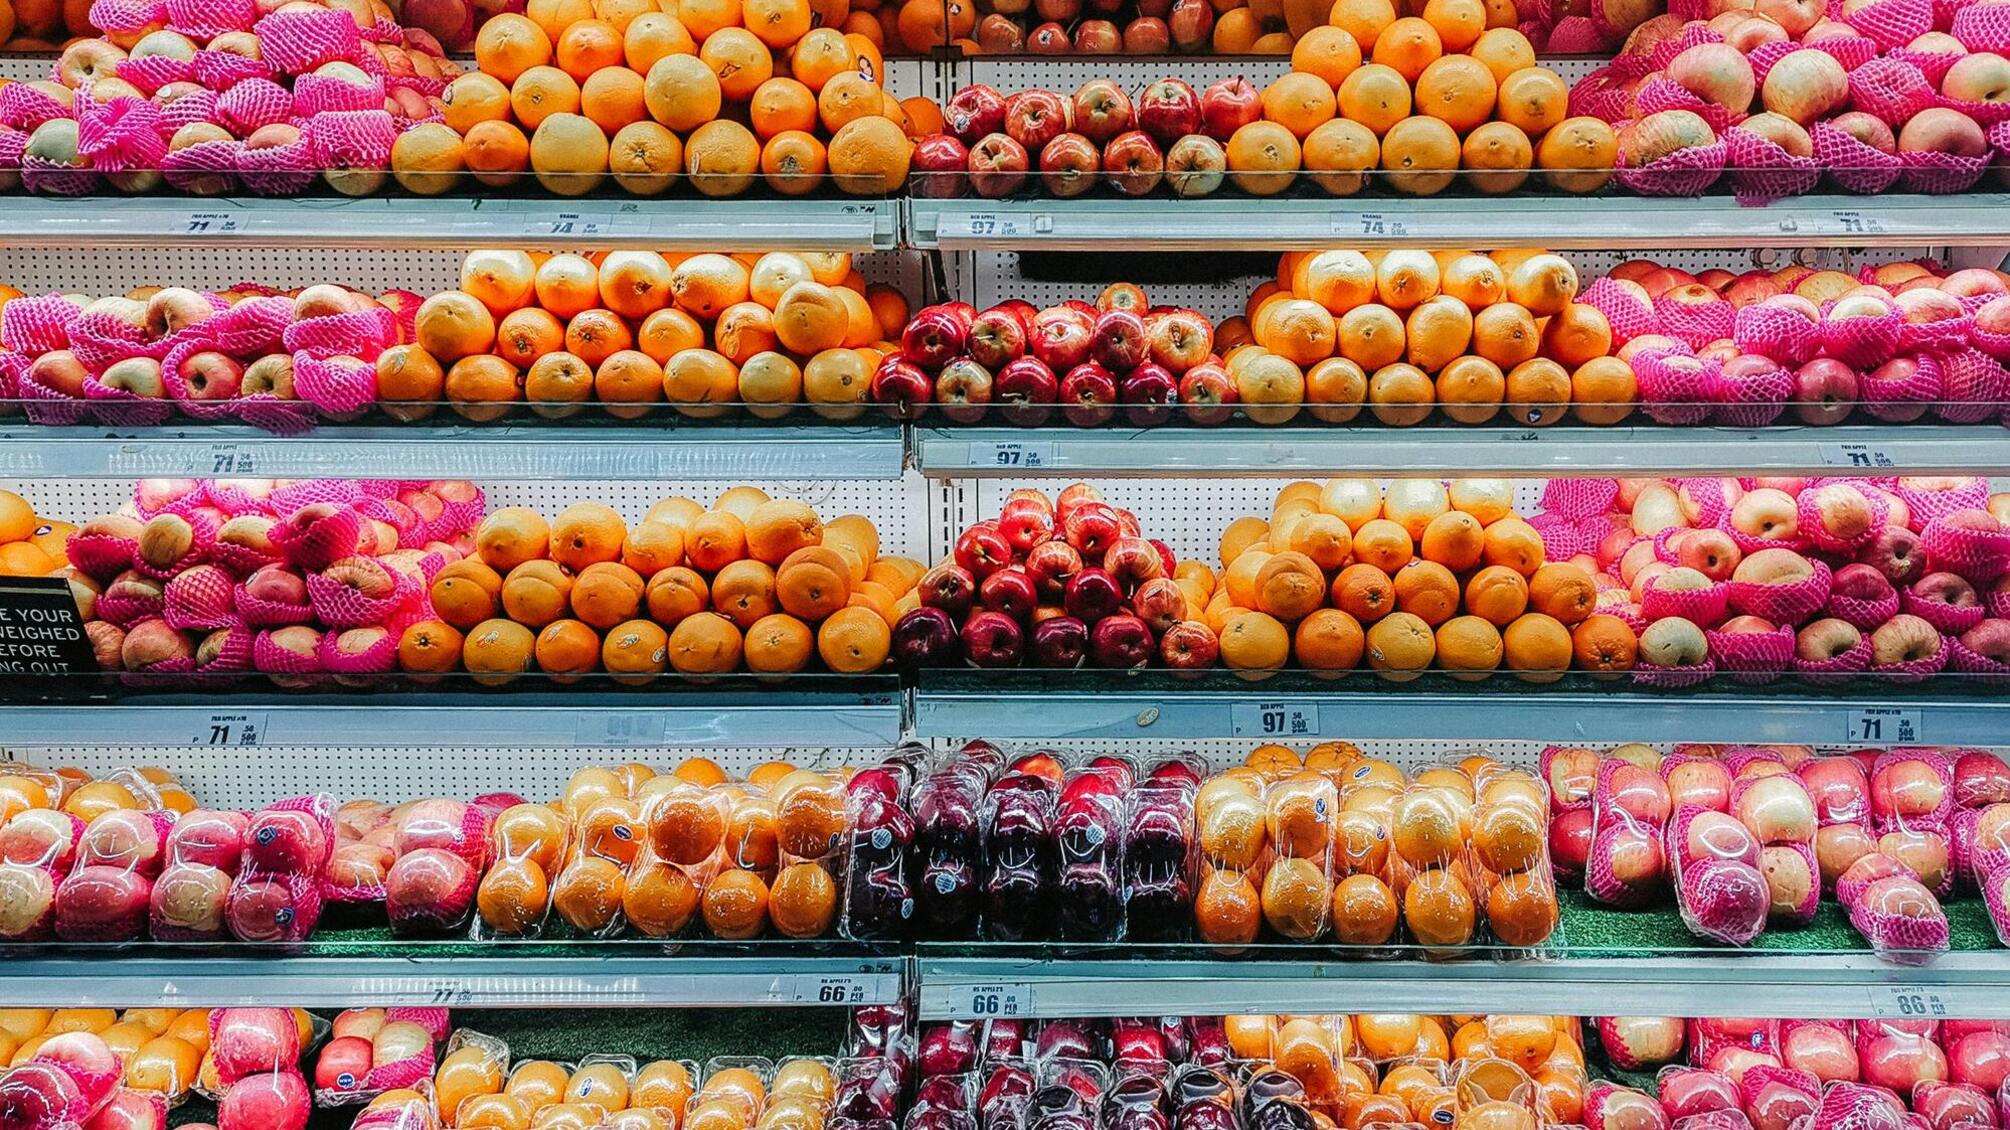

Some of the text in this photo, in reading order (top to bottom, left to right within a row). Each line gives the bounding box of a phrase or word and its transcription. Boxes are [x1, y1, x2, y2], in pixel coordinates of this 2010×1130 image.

[188, 221, 211, 231] 71
[971, 221, 996, 234] 97
[1361, 220, 1384, 234] 74
[1840, 218, 1864, 232] 71
[213, 454, 235, 473] 71
[997, 451, 1021, 465] 97
[1847, 453, 1872, 466] 71
[15, 608, 73, 623] YOUR
[30, 661, 69, 676] OUT
[1262, 711, 1285, 733] 97
[1291, 720, 1307, 729] 500
[1861, 718, 1881, 739] 71
[209, 724, 231, 745] 71
[240, 733, 257, 742] 500
[1898, 727, 1914, 737] 500
[431, 988, 455, 1003] 77
[819, 985, 846, 1002] 66
[850, 992, 864, 1000] PER
[973, 994, 999, 1014] 66
[1004, 1003, 1018, 1012] PER
[1897, 995, 1926, 1014] 86
